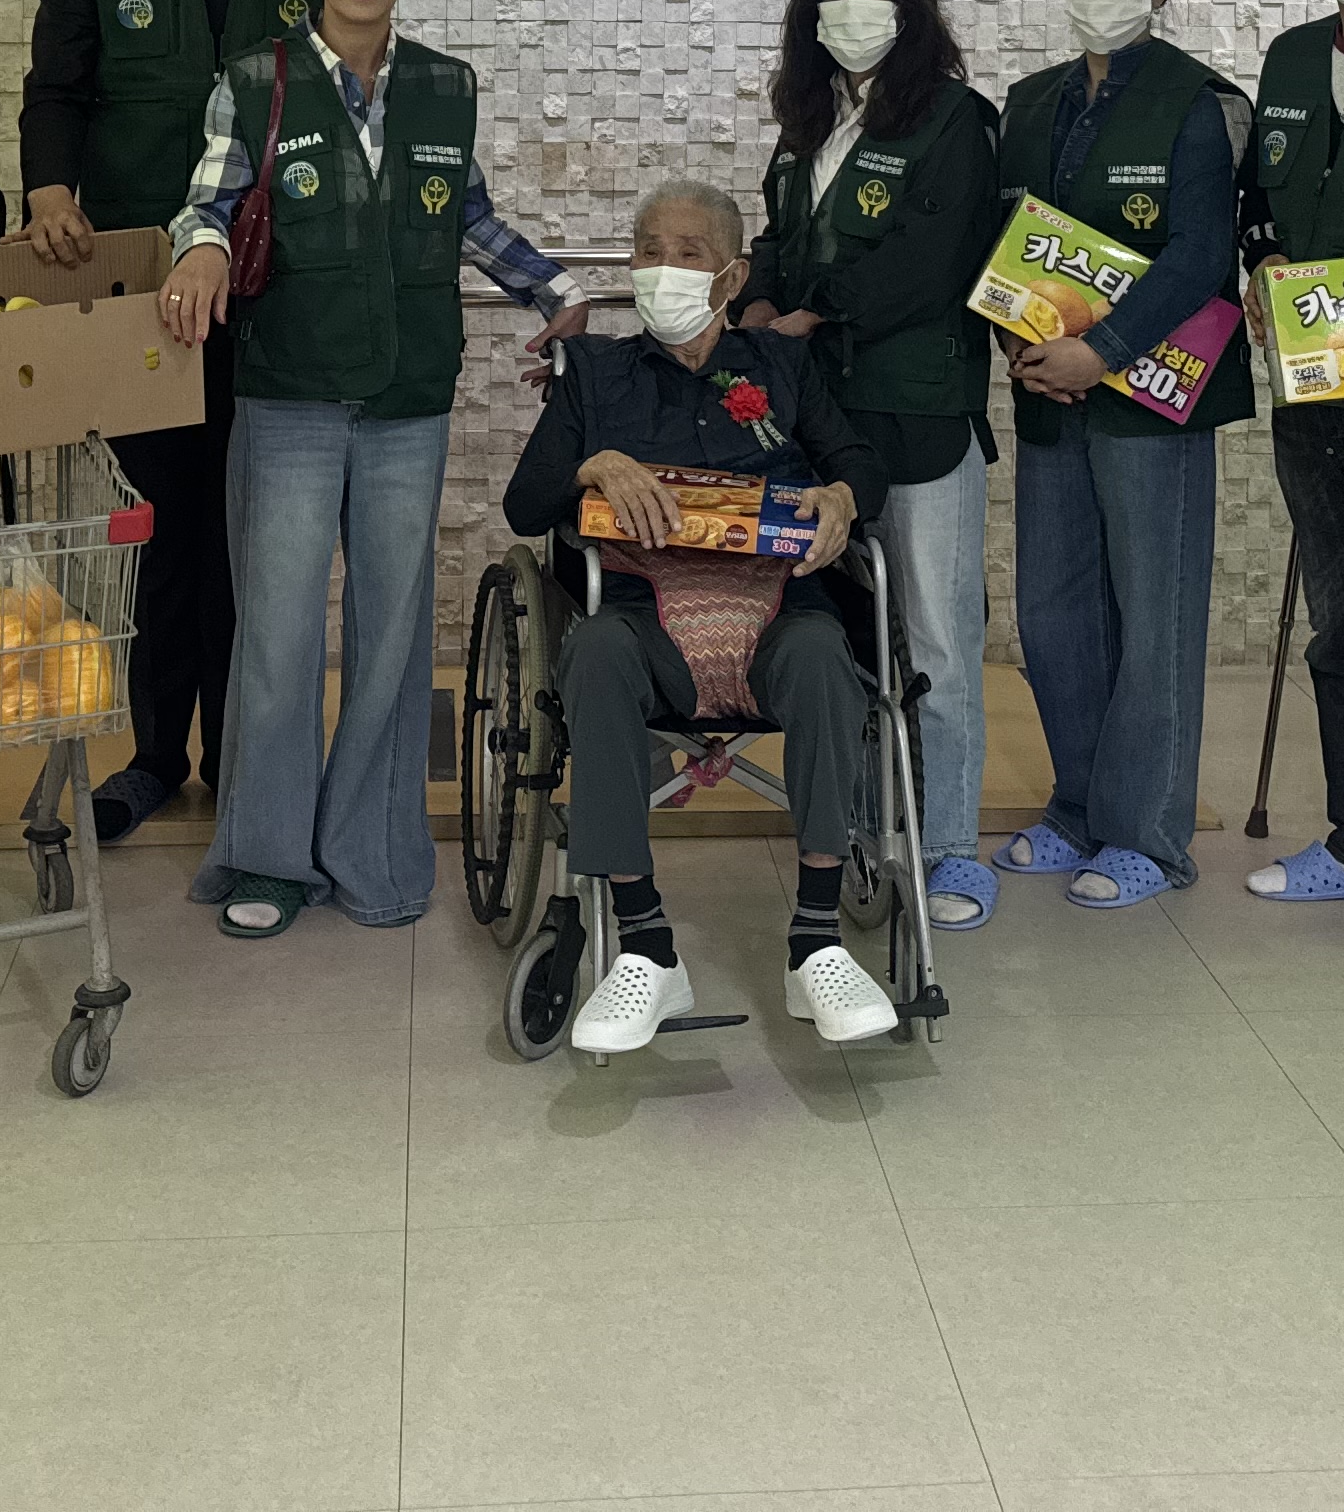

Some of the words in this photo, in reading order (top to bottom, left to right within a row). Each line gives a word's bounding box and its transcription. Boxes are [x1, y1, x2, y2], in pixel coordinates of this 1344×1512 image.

[1263, 105, 1307, 121] KDSMA
[275, 131, 324, 156] DSMA
[1022, 232, 1134, 306] 카스타
[1286, 266, 1328, 280] 오리온
[1127, 356, 1189, 411] 30개
